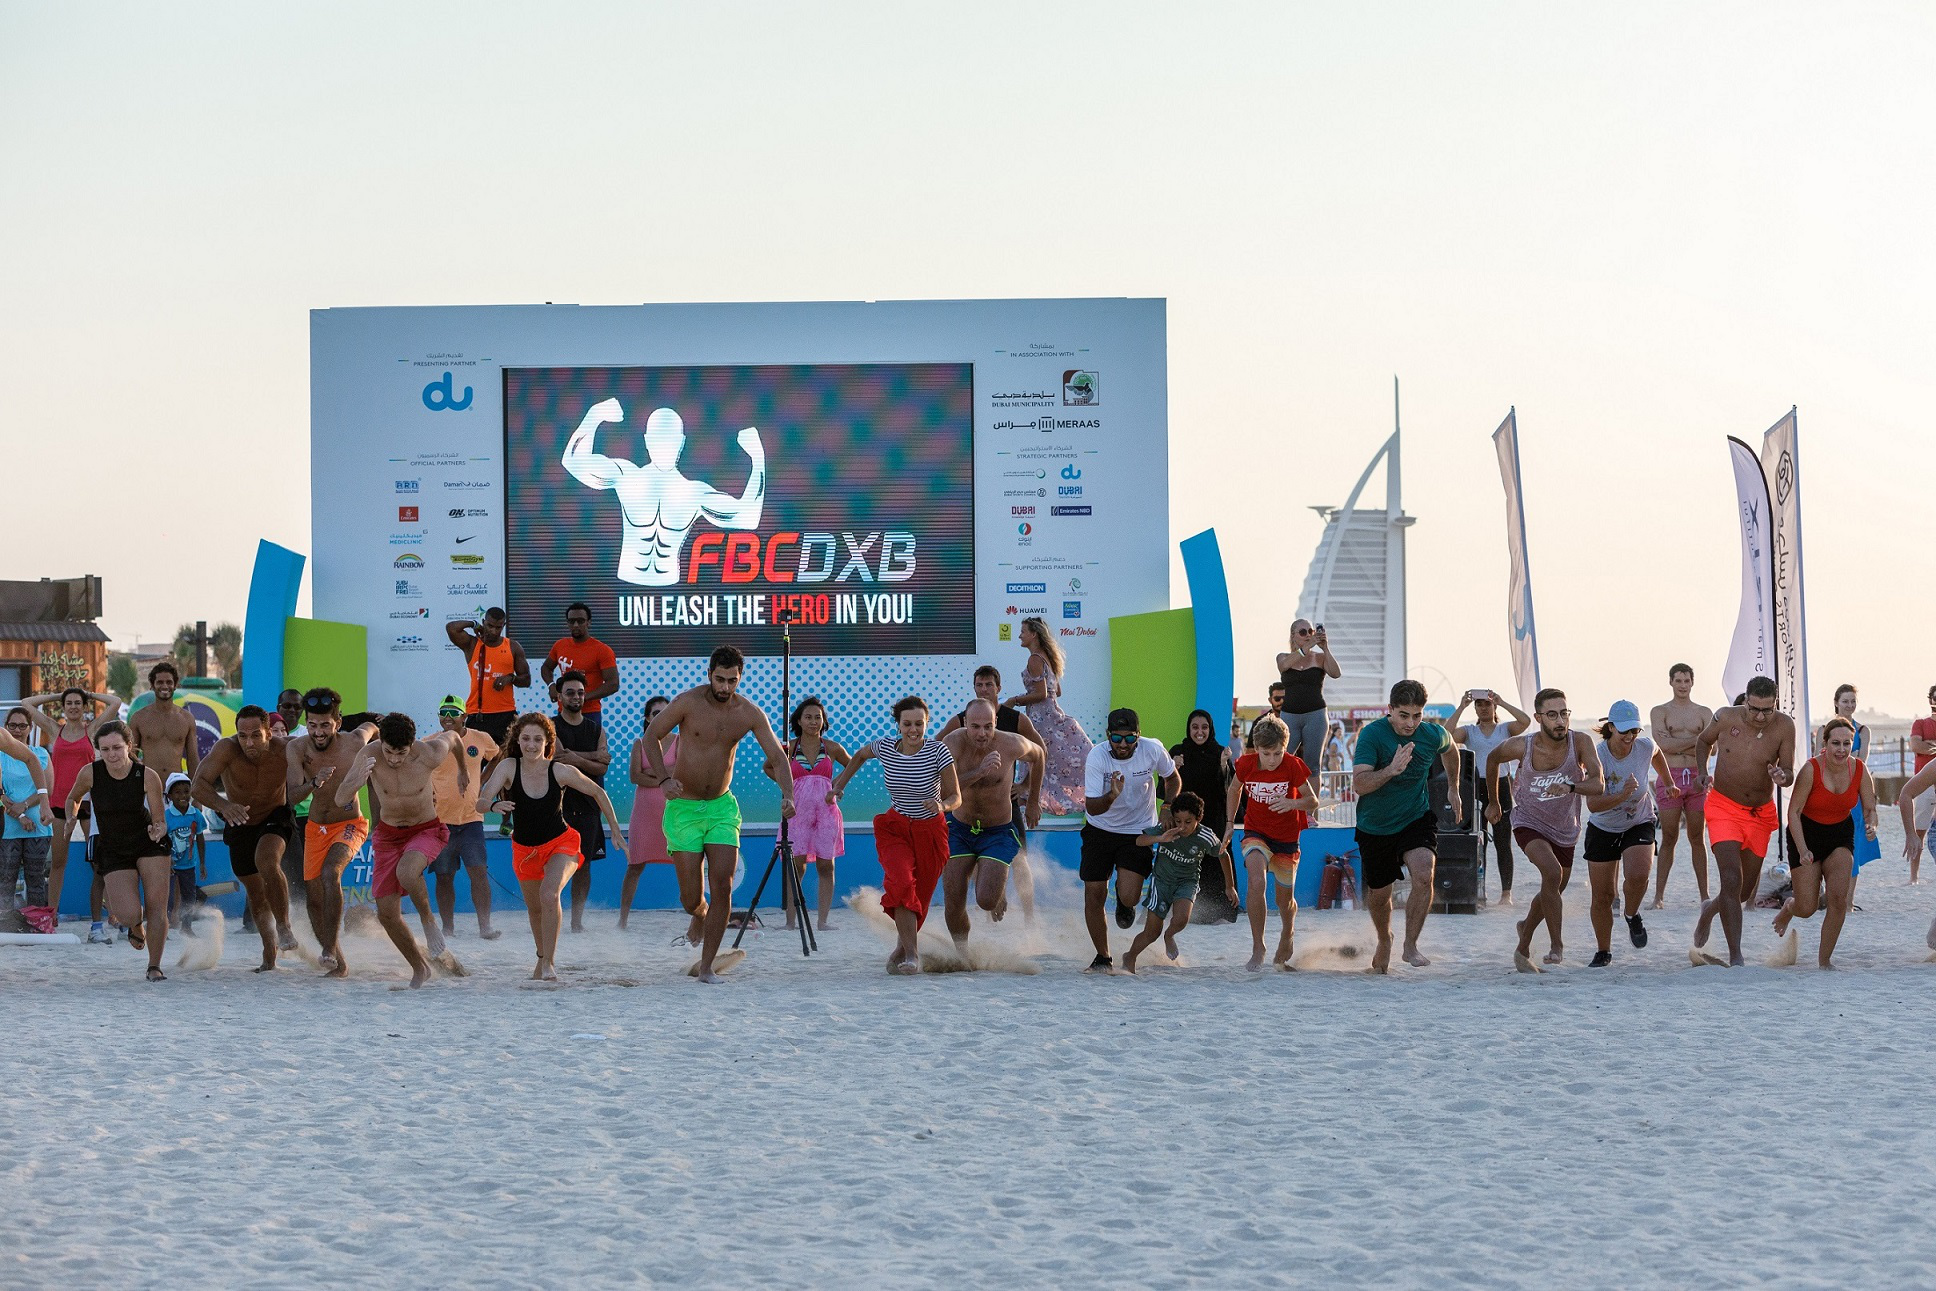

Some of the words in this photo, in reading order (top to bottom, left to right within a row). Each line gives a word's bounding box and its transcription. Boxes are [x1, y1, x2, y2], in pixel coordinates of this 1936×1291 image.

[422, 371, 473, 411] du
[993, 420, 1037, 430] مراس
[1057, 420, 1100, 429] MERAAS
[1061, 464, 1082, 480] du
[1058, 486, 1082, 495] DUBAI
[1012, 506, 1035, 514] DUBAI
[687, 532, 917, 583] FBCDXB
[618, 595, 717, 626] UNLEASH
[724, 594, 766, 625] THE
[771, 594, 829, 625] HERO
[836, 594, 858, 624] IN
[862, 594, 913, 624] YOU!
[1060, 628, 1075, 636] Mai
[1076, 627, 1097, 636] Dubai
[1353, 710, 1382, 718] SHOP
[1159, 846, 1195, 864] Emirates
